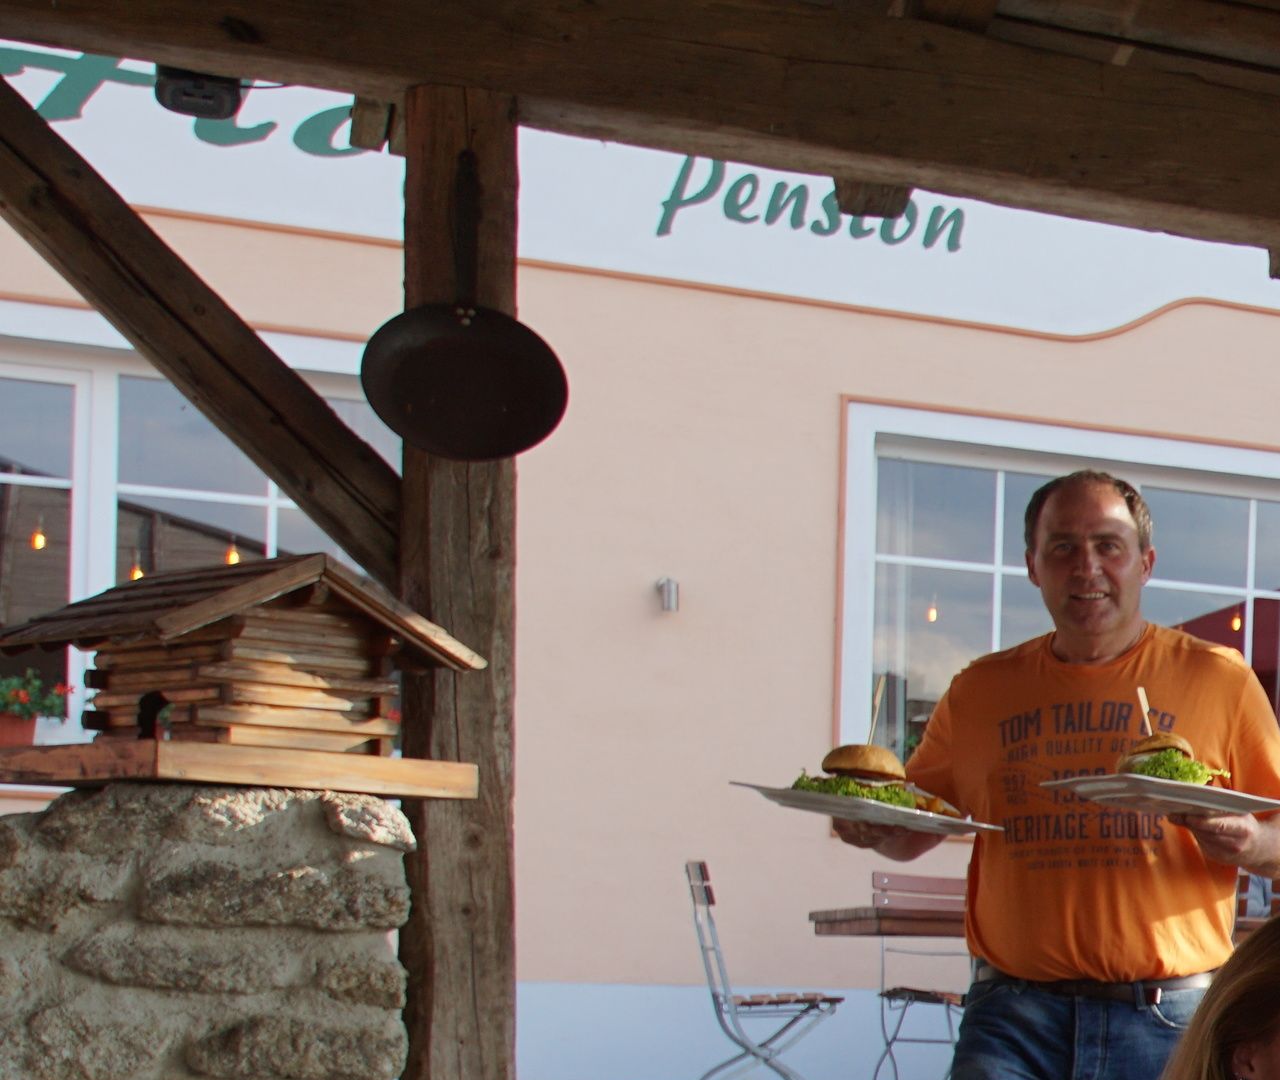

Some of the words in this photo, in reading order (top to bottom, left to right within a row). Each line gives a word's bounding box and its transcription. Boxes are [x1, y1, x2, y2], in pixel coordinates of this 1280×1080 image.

[998, 706, 1042, 748] TOM
[1051, 701, 1134, 735] TAILOR
[1045, 737, 1102, 756] QUALITY
[1004, 813, 1089, 843] HERITAGE
[1100, 810, 1164, 841] GOODS
